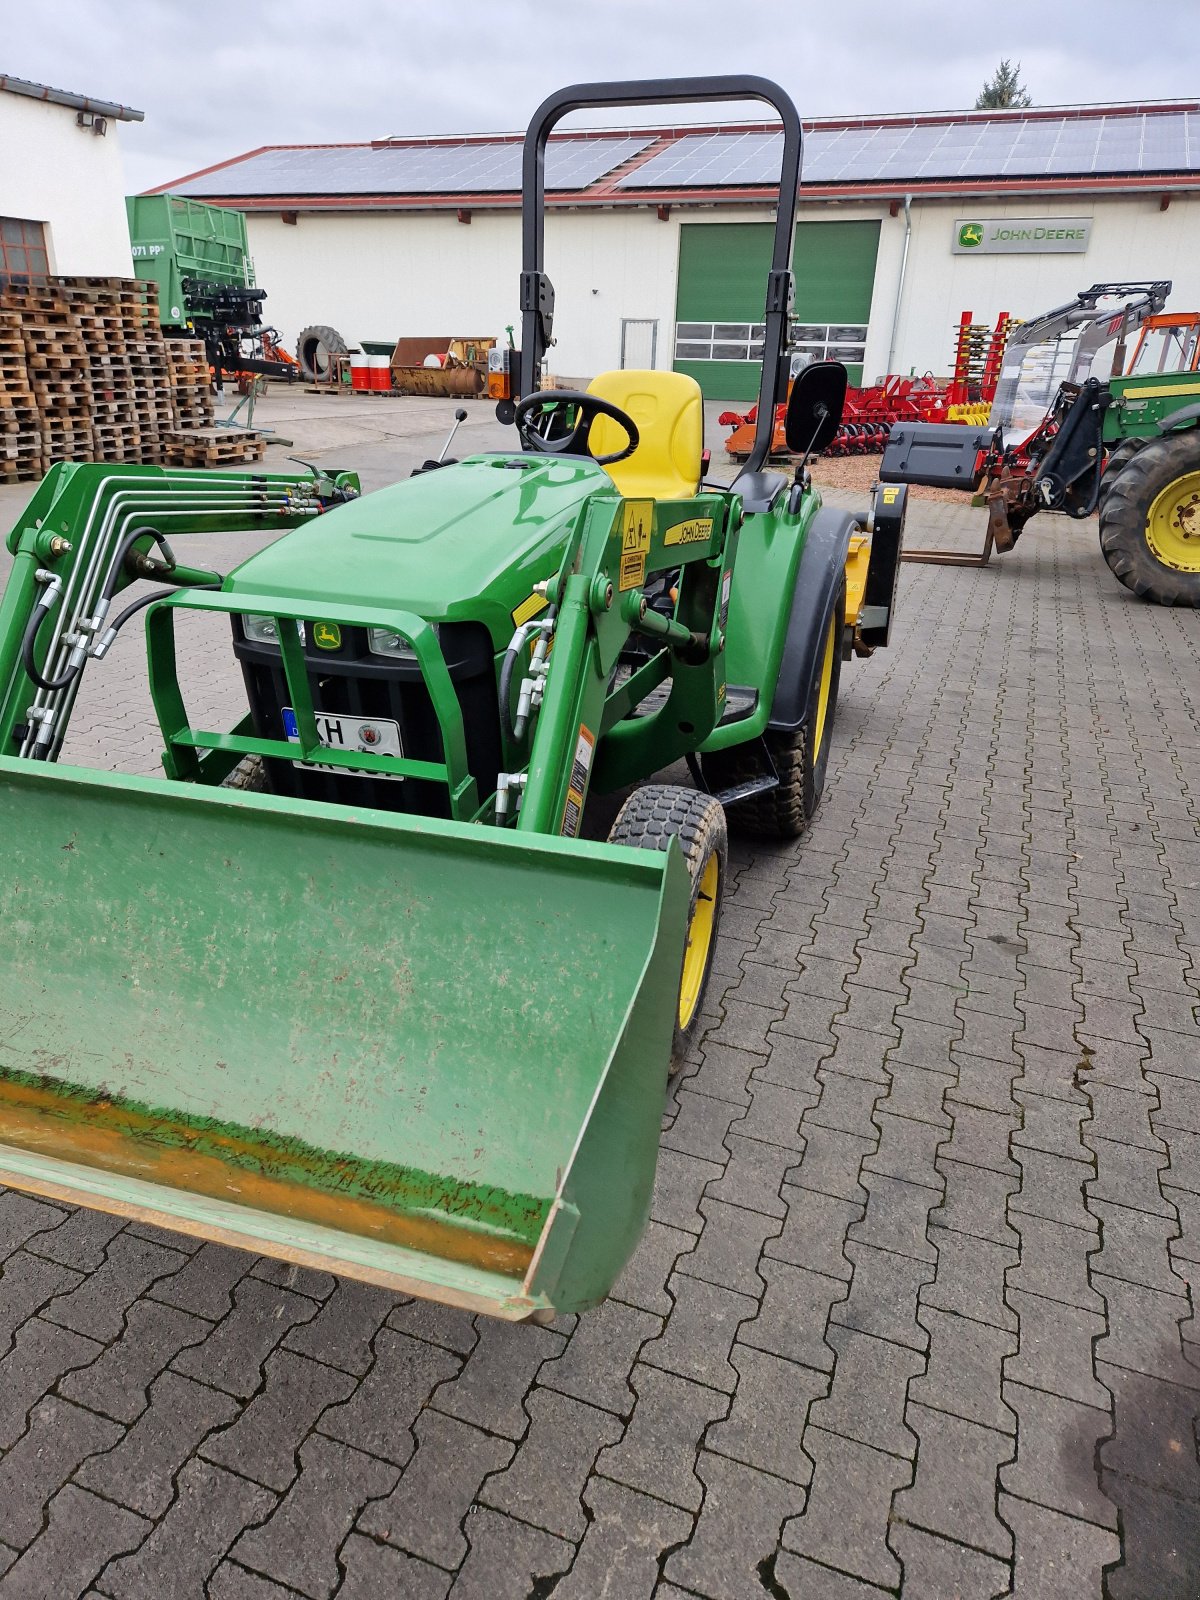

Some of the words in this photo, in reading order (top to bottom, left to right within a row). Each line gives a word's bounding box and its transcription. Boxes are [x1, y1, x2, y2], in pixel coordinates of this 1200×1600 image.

[991, 228, 1031, 241] JOHN
[1034, 227, 1085, 240] DEERE
[131, 246, 146, 256] 071
[679, 525, 695, 542] JOHN
[695, 521, 711, 540] DEERE
[293, 727, 299, 736] D
